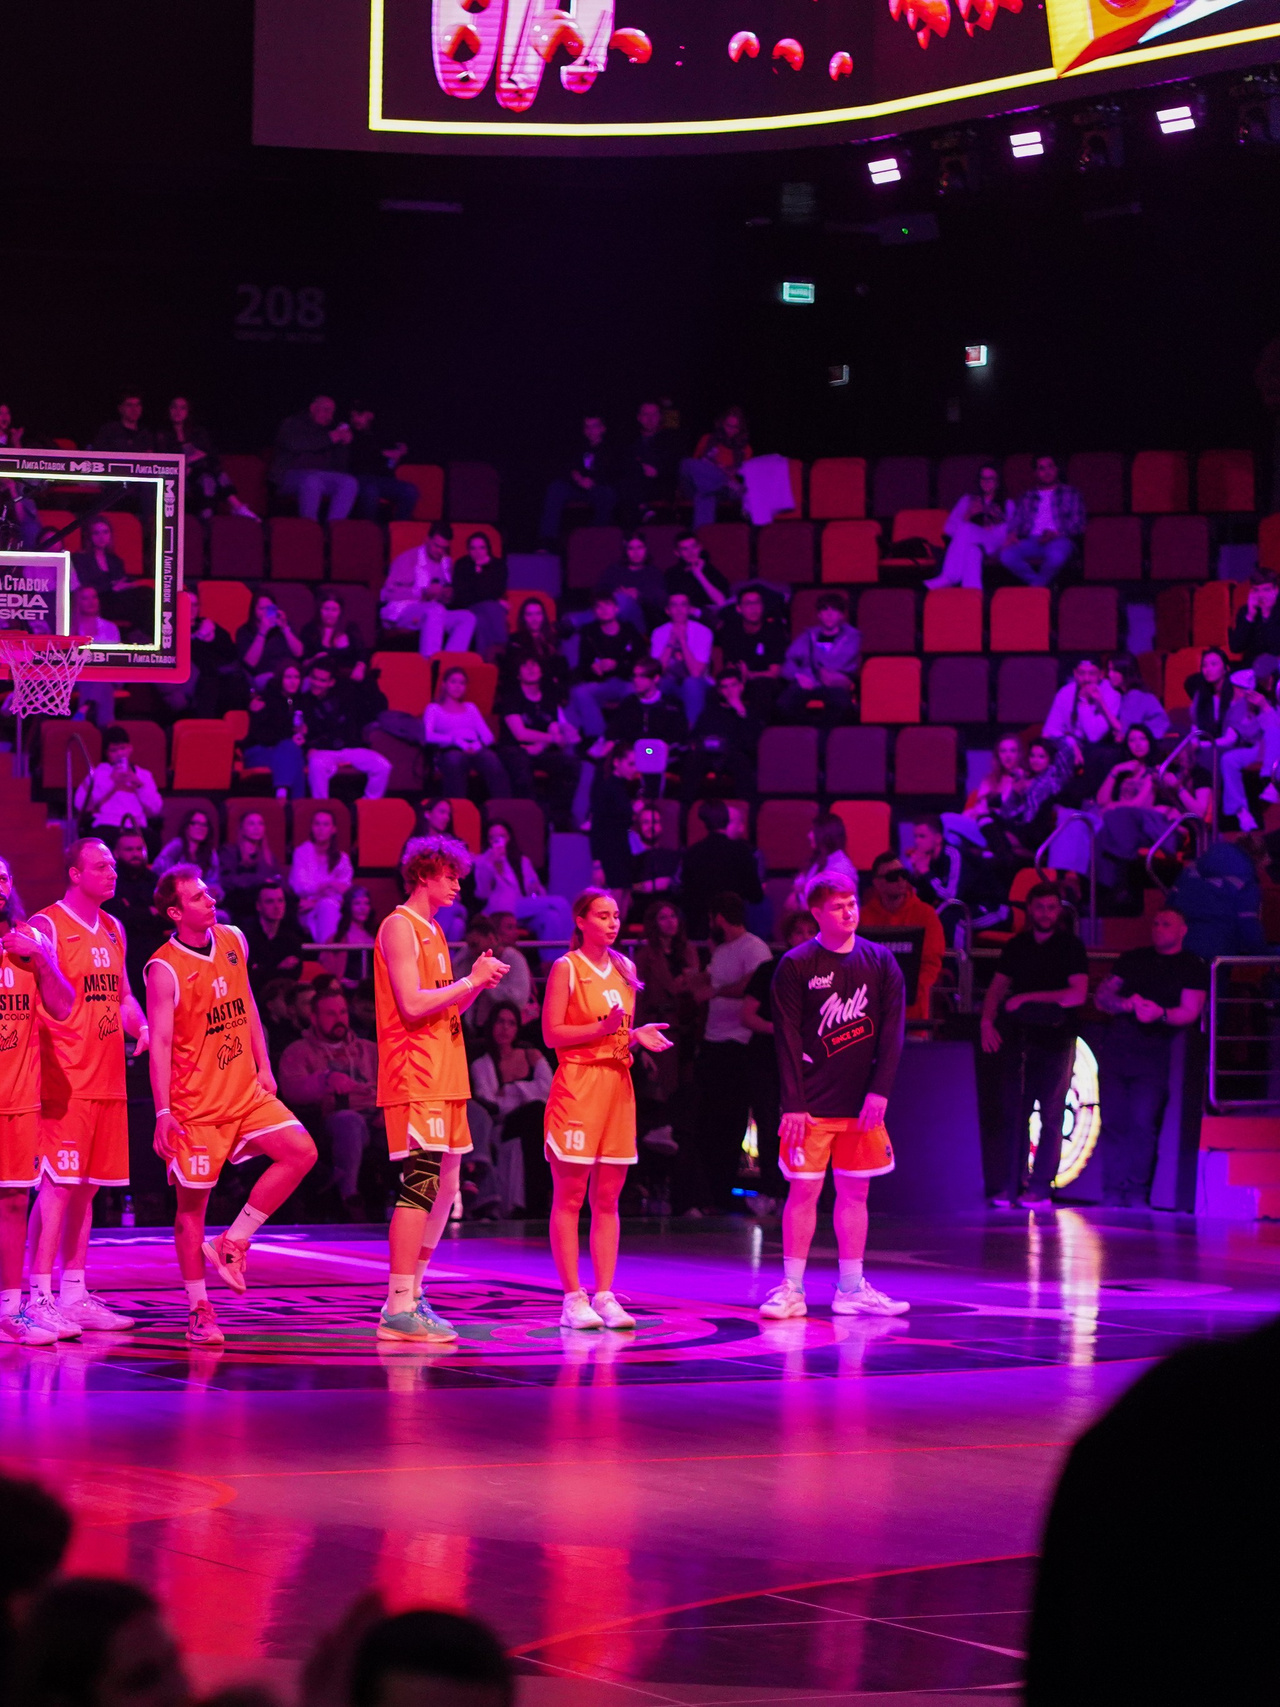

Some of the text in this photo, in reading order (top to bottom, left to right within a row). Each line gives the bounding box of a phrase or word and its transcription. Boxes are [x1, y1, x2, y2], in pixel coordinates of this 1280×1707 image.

[234, 283, 326, 328] 208
[91, 946, 111, 969] 33
[211, 975, 229, 1000] 15
[601, 988, 624, 1012] 19
[3, 1012, 31, 1021] COLOR
[831, 1030, 851, 1046] SINCE
[426, 1117, 445, 1139] 10
[563, 1129, 586, 1151] 19
[56, 1149, 80, 1171] 33
[188, 1154, 211, 1176] 15
